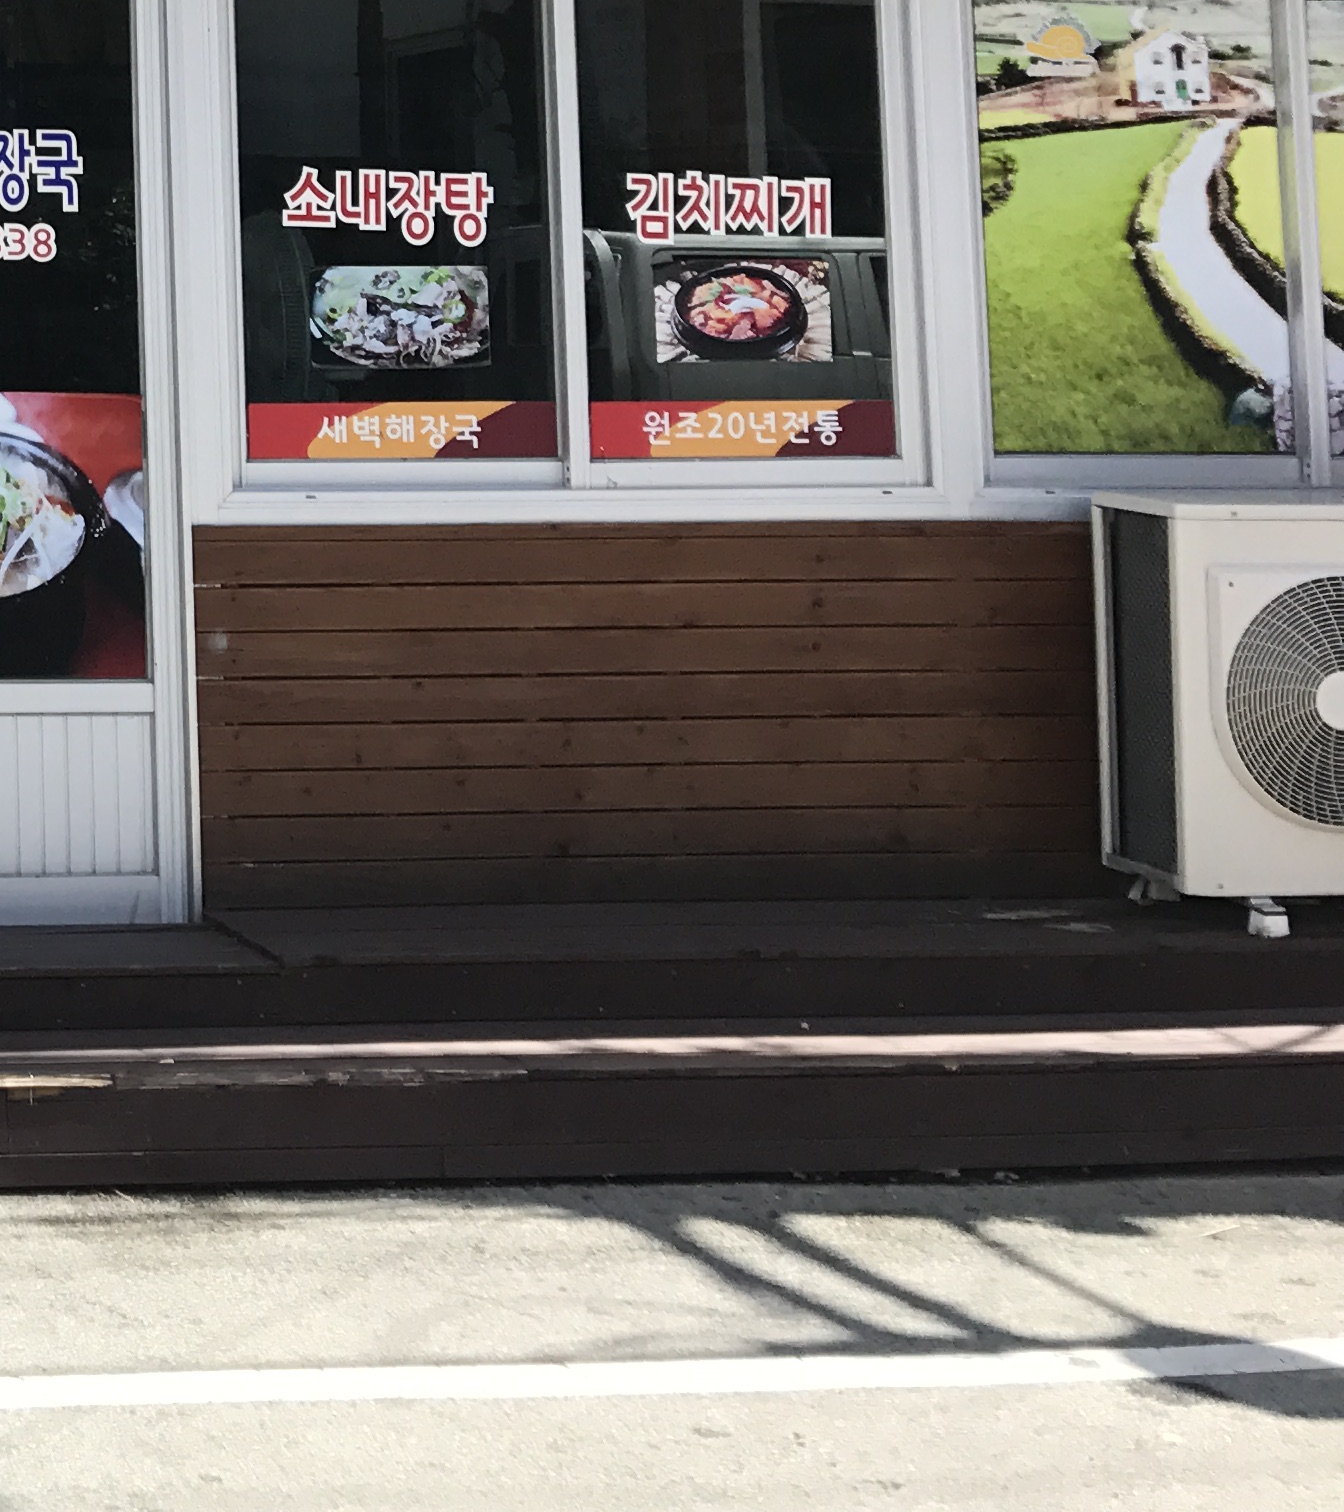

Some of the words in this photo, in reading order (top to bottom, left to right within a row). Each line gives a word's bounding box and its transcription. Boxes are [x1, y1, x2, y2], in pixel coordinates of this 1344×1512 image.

[282, 166, 494, 247] 소내장탕
[625, 171, 832, 244] 김치찌개
[317, 412, 482, 449] 새벽해장국
[642, 409, 843, 447] 원조20년전통
